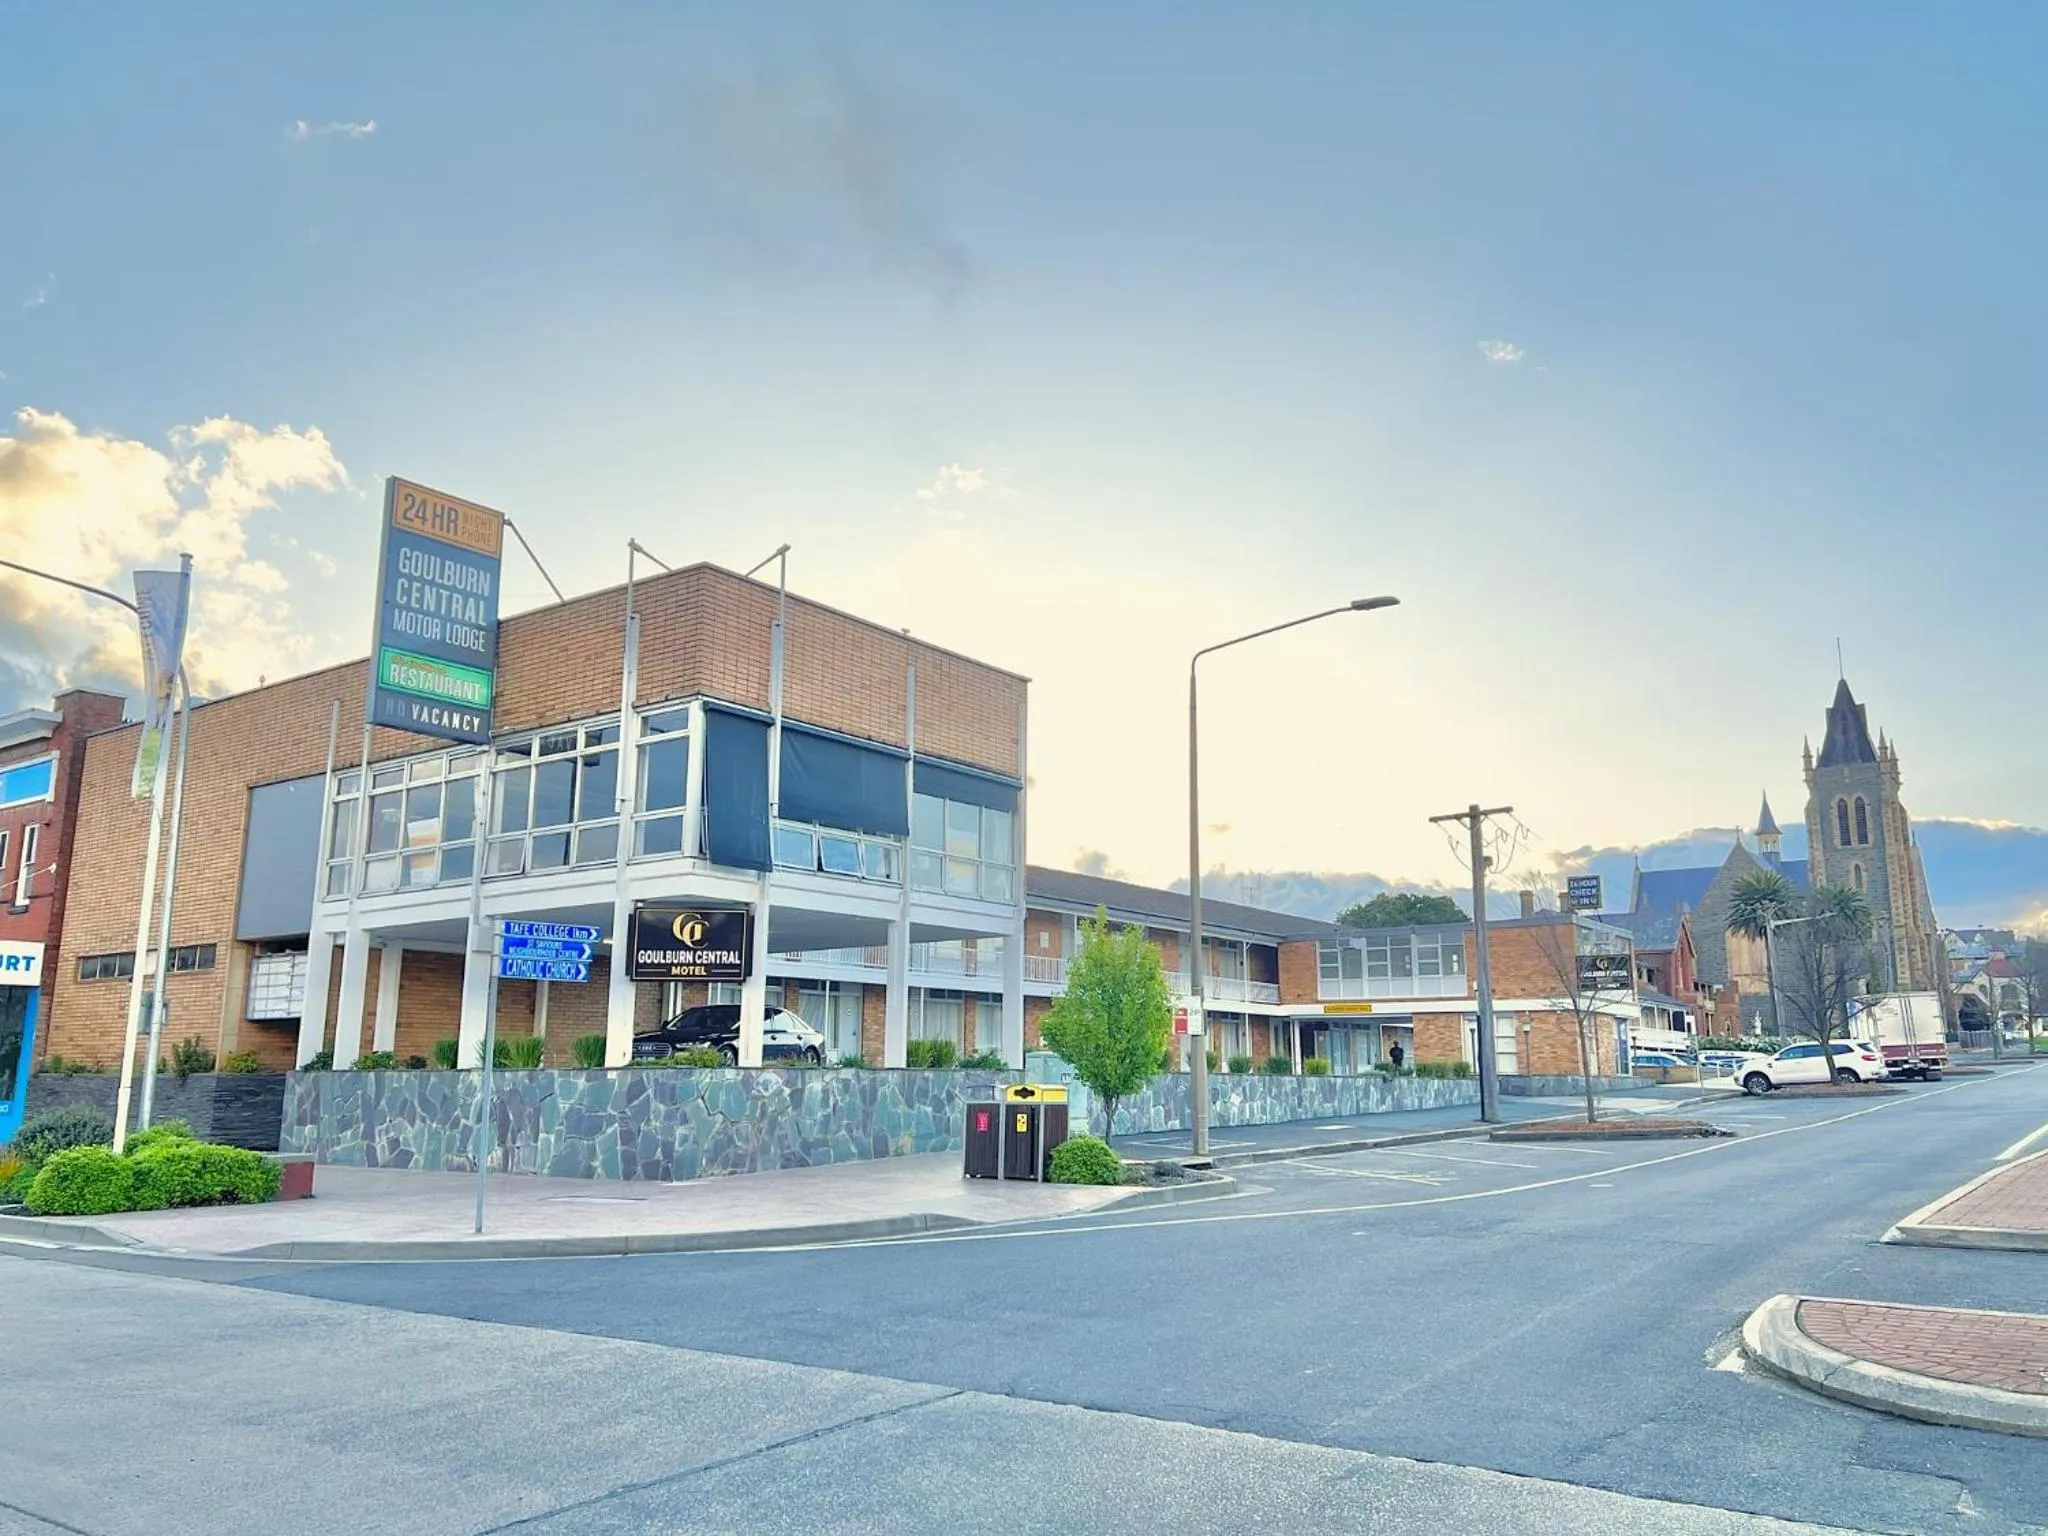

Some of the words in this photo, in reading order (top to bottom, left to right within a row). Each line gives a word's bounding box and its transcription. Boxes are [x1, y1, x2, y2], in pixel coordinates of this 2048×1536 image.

[402, 493, 428, 525] 24
[431, 502, 459, 536] HR
[461, 509, 493, 529] NIGHT
[461, 526, 493, 547] PHONE
[398, 547, 491, 597] GOULBURN
[395, 578, 488, 626] CENTRAL
[393, 608, 441, 641] MOTOR
[445, 621, 487, 652] LODGE
[388, 664, 482, 701] RESTAURANT
[412, 703, 481, 733] VACANCY
[1570, 888, 1597, 897] CHECK
[510, 922, 529, 935] TAFE
[532, 924, 569, 938] COLLEGE
[0, 954, 36, 972] RT
[638, 949, 694, 964] GOULBURN
[695, 950, 741, 965] CENTRAL
[506, 959, 544, 977] CATHOLIC
[545, 961, 577, 979] CHURCH
[671, 966, 707, 976] MOTEL
